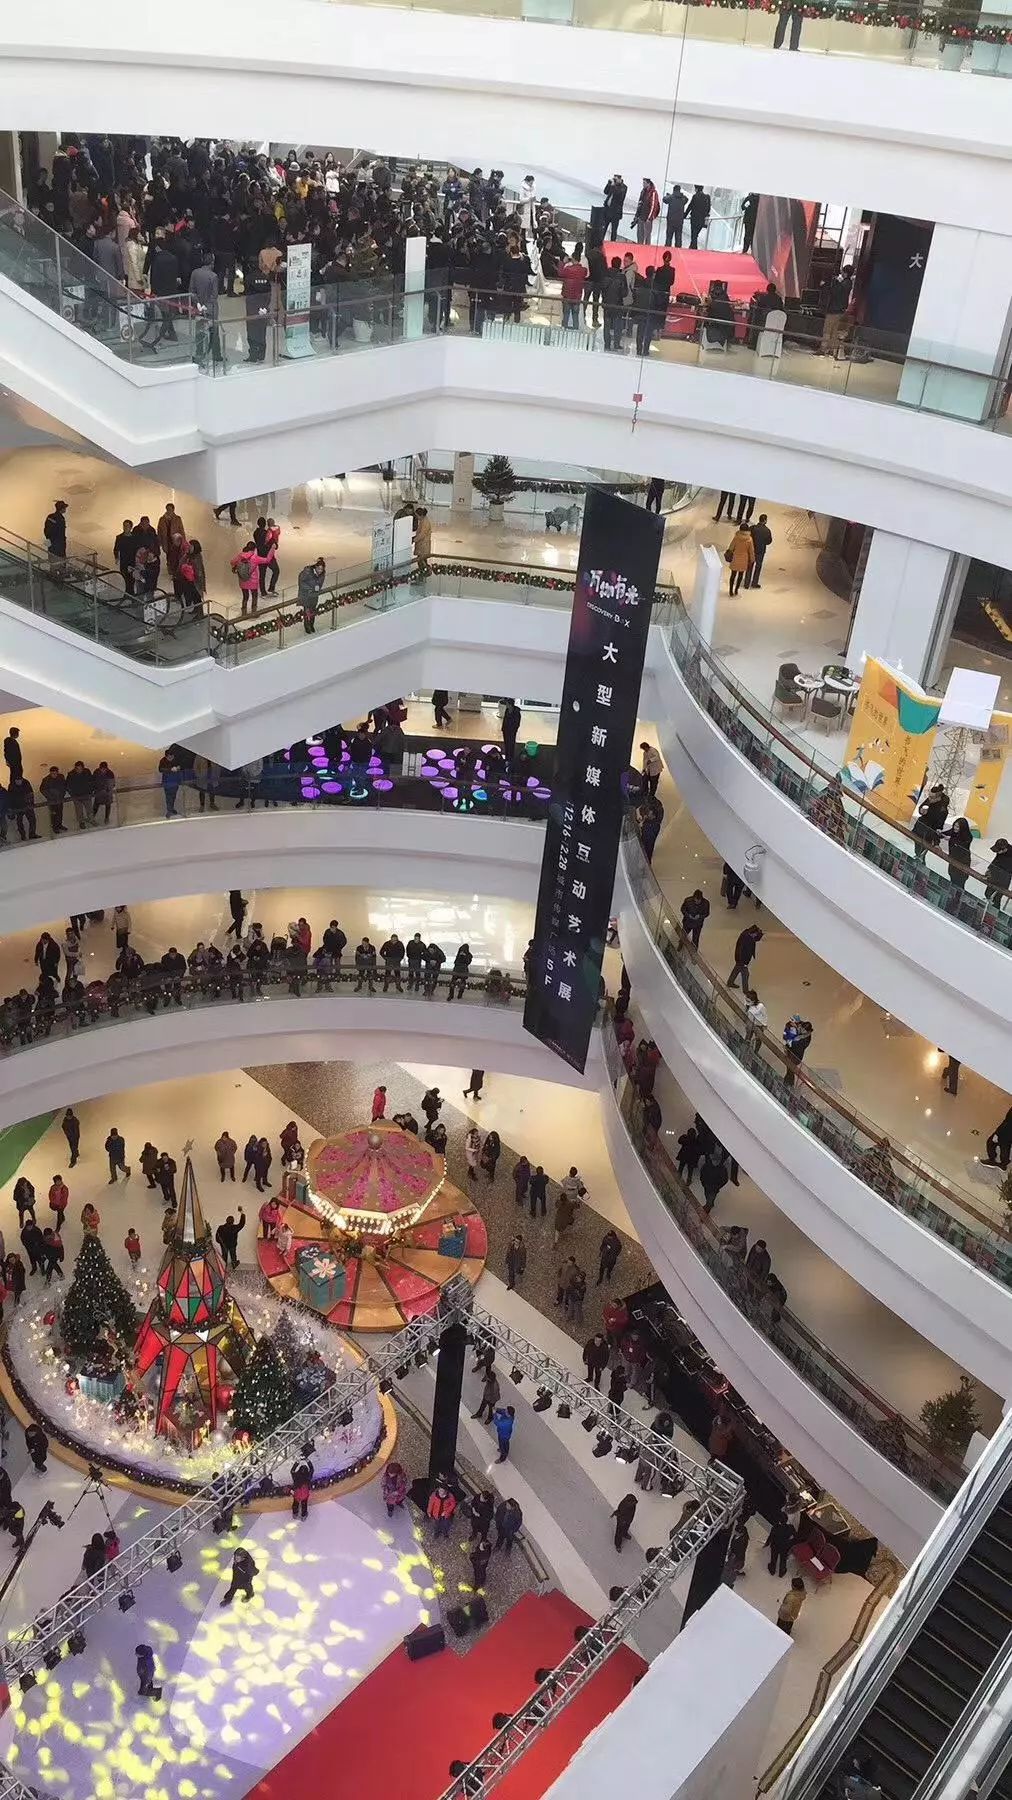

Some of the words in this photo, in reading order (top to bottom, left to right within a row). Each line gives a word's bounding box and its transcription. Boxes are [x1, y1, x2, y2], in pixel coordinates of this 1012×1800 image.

[908, 252, 924, 269] 大
[558, 642, 618, 1001] 大型新媒体互动艺术展
